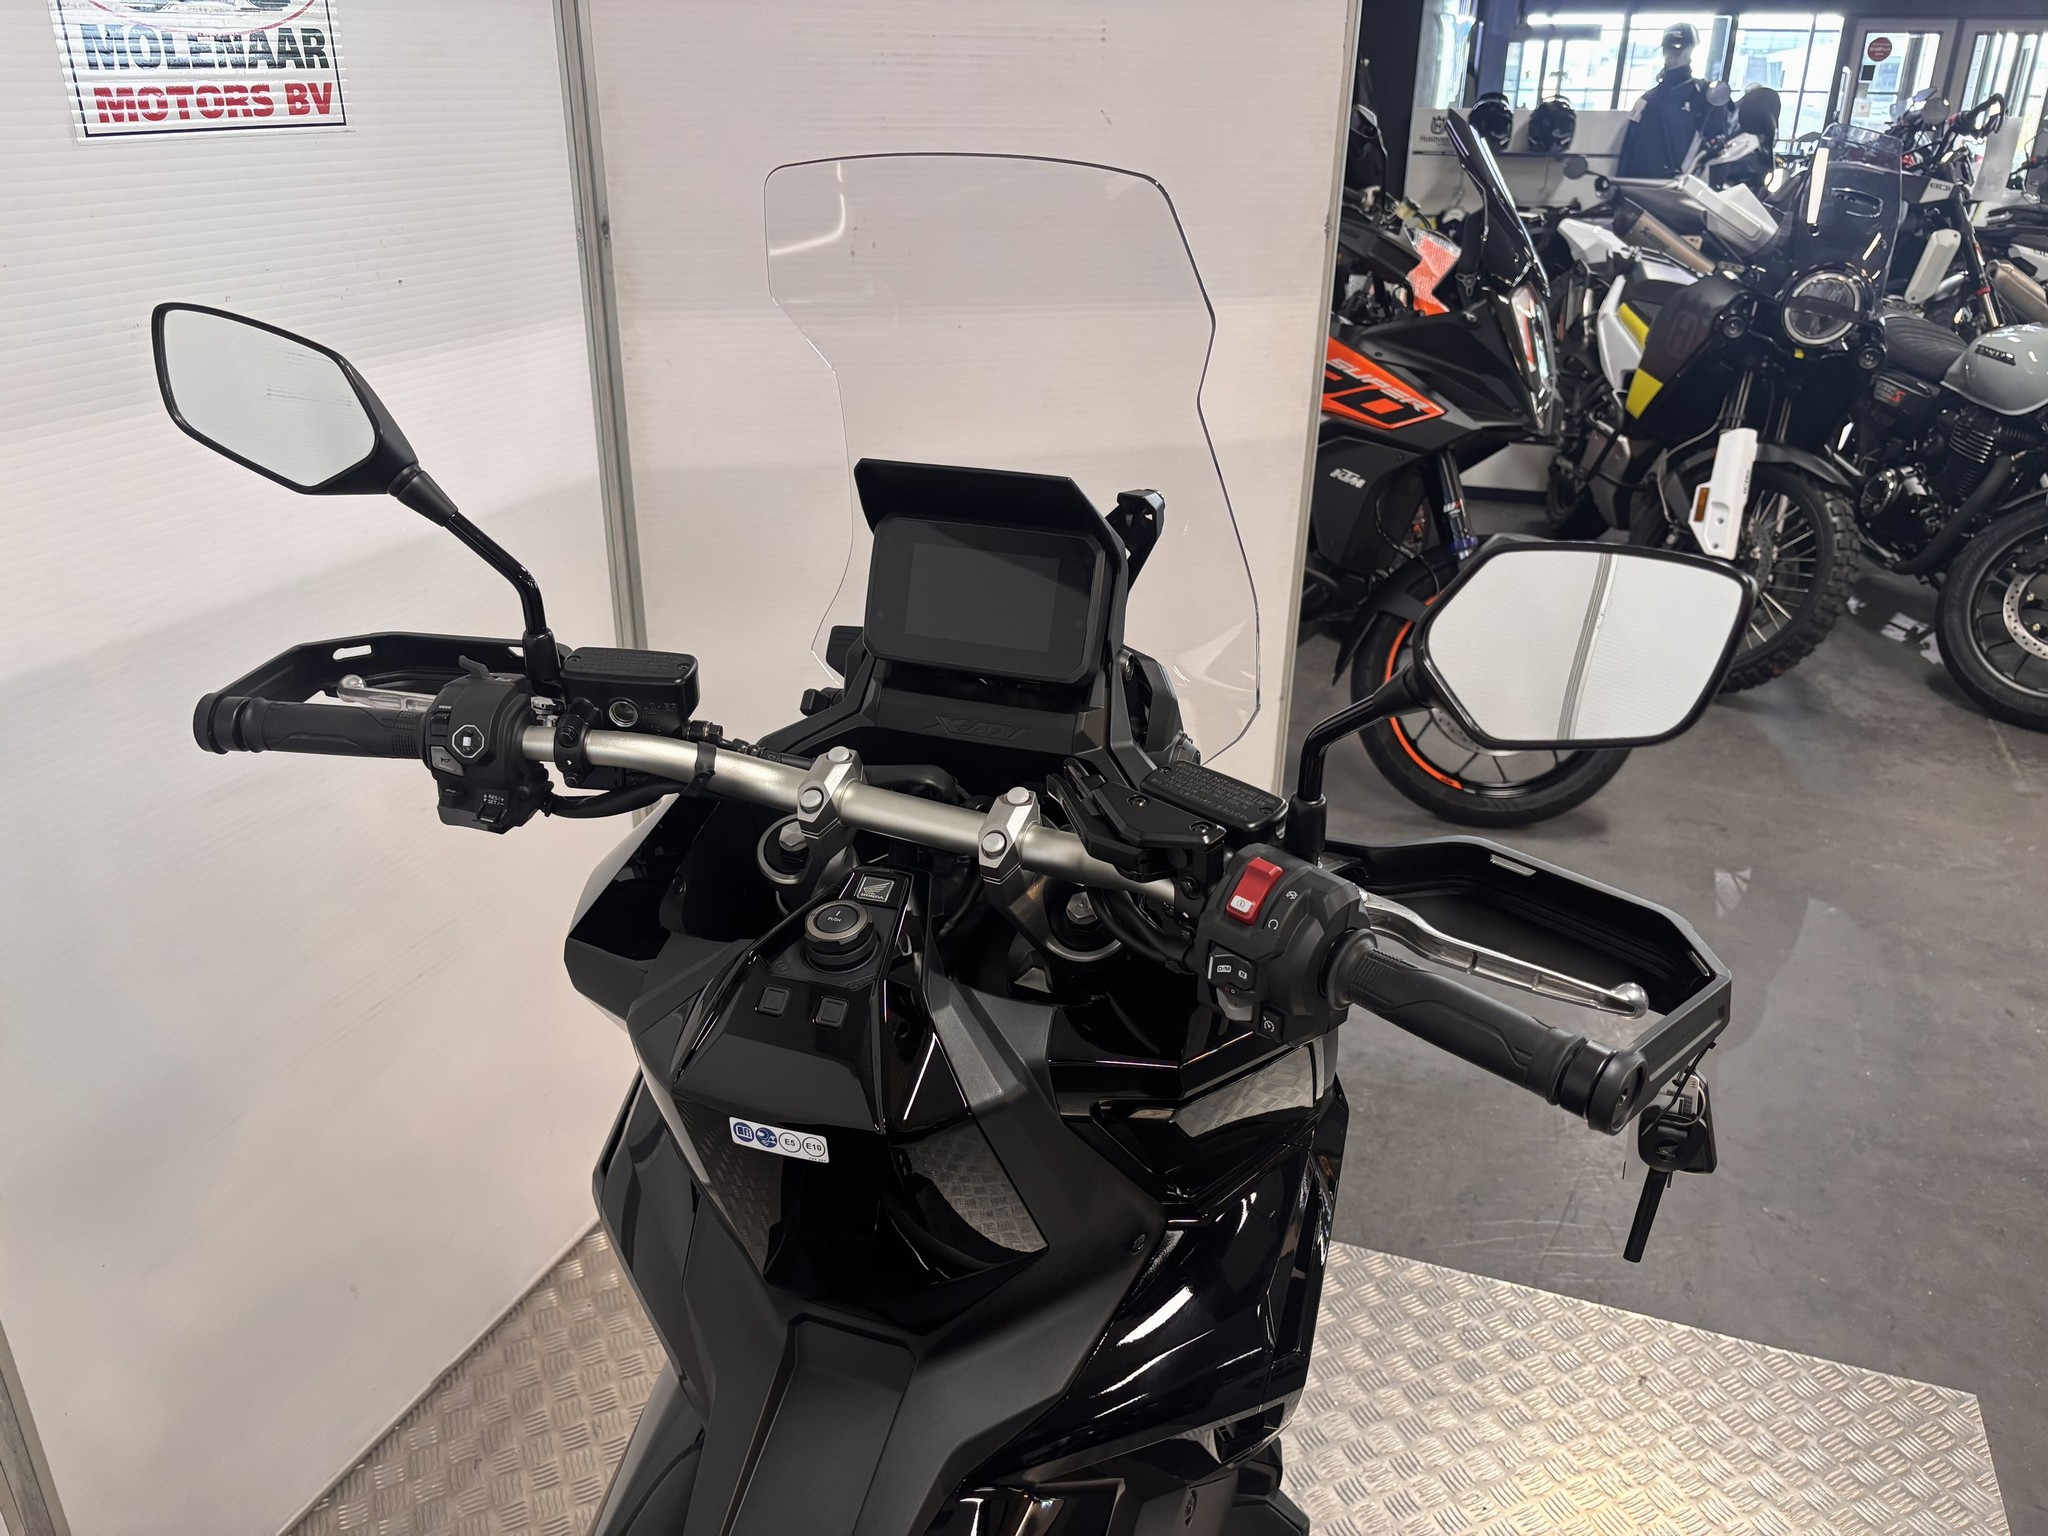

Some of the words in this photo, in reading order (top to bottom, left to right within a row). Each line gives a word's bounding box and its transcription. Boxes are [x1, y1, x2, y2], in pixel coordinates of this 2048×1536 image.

[79, 23, 331, 70] MOLENAAR
[93, 83, 275, 123] MOTORS
[284, 82, 333, 116] BV
[1326, 358, 1431, 413] SUPER
[1329, 467, 1367, 489] KTM
[784, 1138, 796, 1147] E5
[805, 1142, 822, 1152] E10
